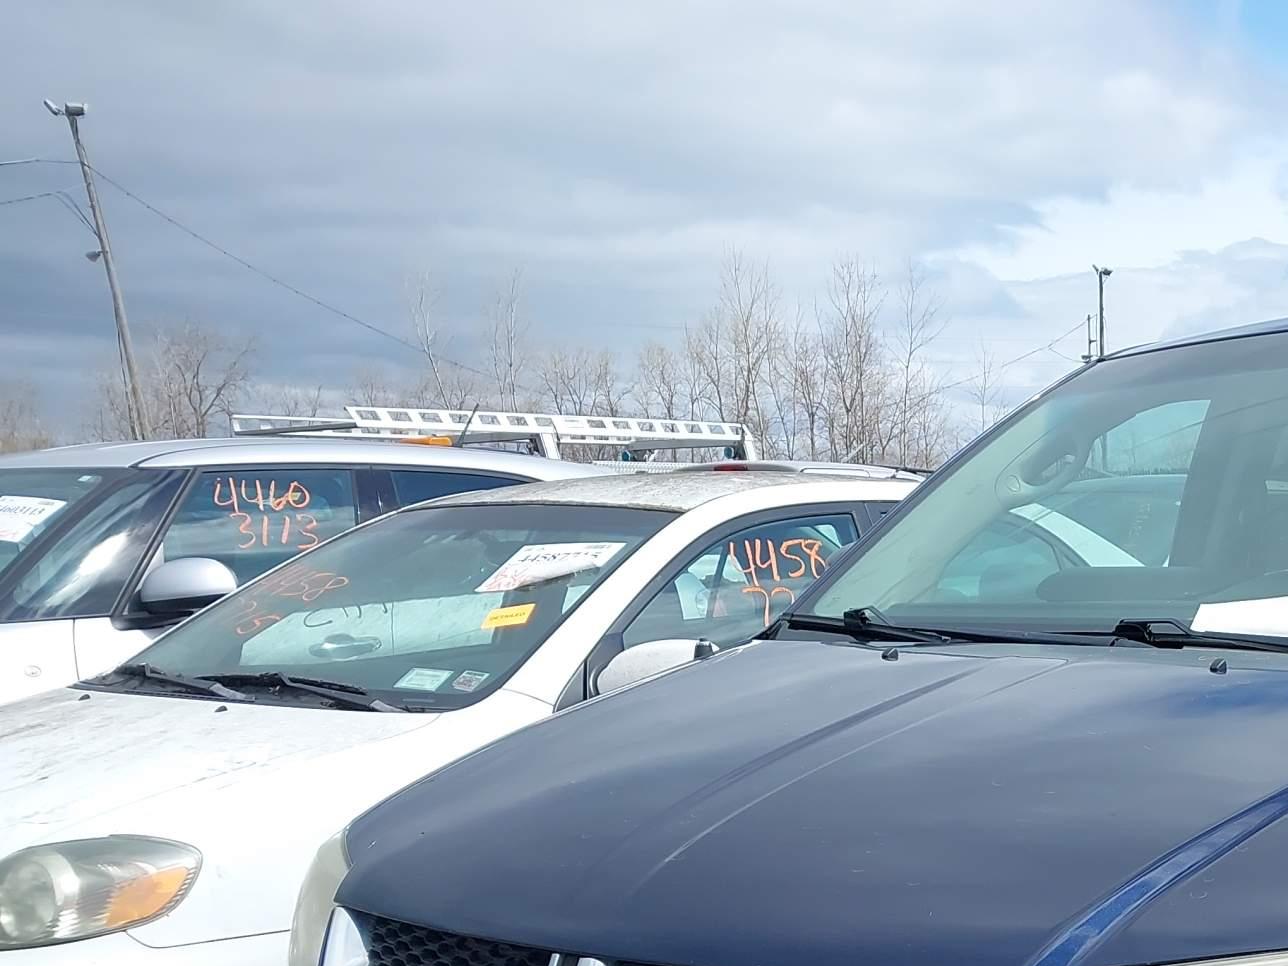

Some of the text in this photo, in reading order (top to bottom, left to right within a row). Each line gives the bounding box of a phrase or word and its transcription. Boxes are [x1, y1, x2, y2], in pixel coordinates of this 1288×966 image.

[213, 477, 310, 514] 4460
[229, 512, 319, 549] 3113
[729, 538, 828, 588] 4458
